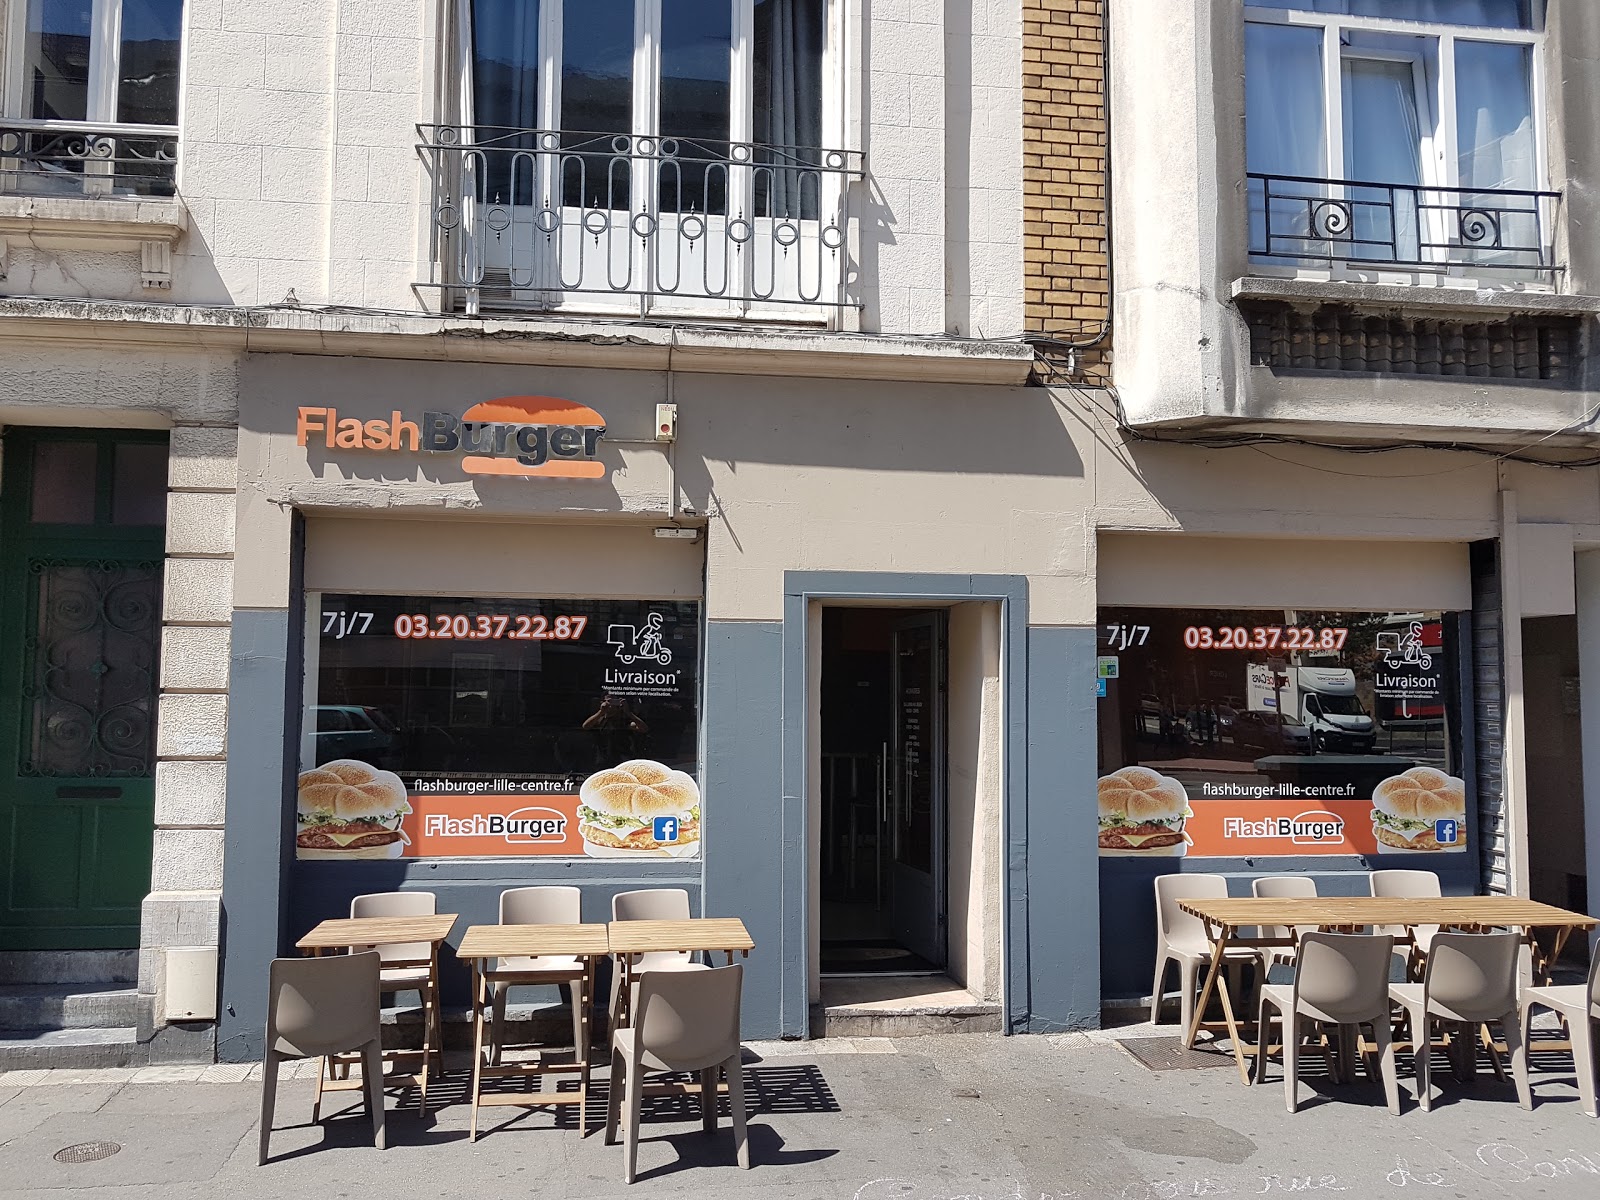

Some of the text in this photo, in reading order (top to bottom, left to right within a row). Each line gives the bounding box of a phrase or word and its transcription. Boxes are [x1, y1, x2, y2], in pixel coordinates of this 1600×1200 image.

[296, 406, 607, 467] FlashBurger
[322, 611, 588, 640] 7j/7 03.20.37.22.87
[1106, 625, 1349, 651] 7j/7 03.20.37.22.87
[414, 779, 574, 794] flashburger-lille-centre.fr
[1202, 782, 1356, 798] flashburger-lille-centre.fr
[425, 812, 568, 838] FlashBurger
[1224, 816, 1345, 840] FlashBurger
